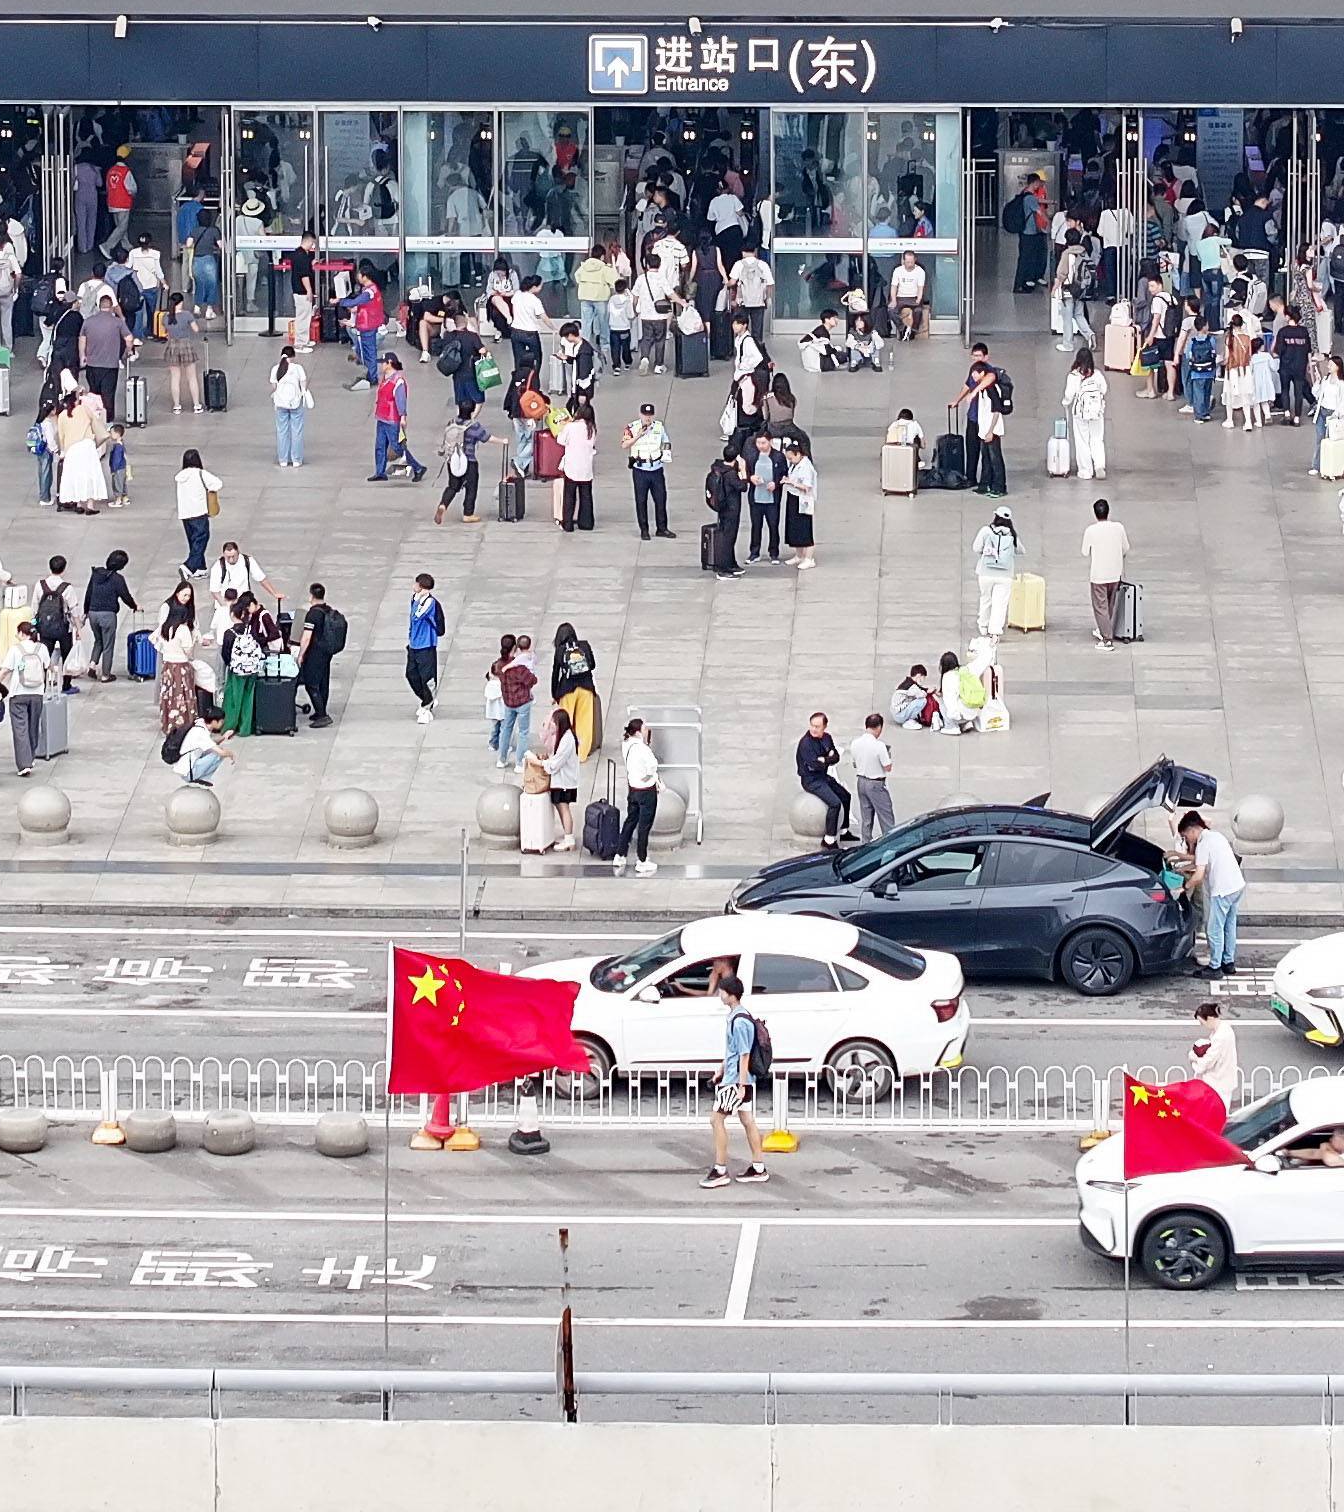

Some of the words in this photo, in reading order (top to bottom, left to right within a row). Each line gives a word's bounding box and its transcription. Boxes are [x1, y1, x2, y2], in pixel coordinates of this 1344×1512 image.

[655, 36, 876, 93] 进站口(东)
[655, 74, 729, 92] Entrance
